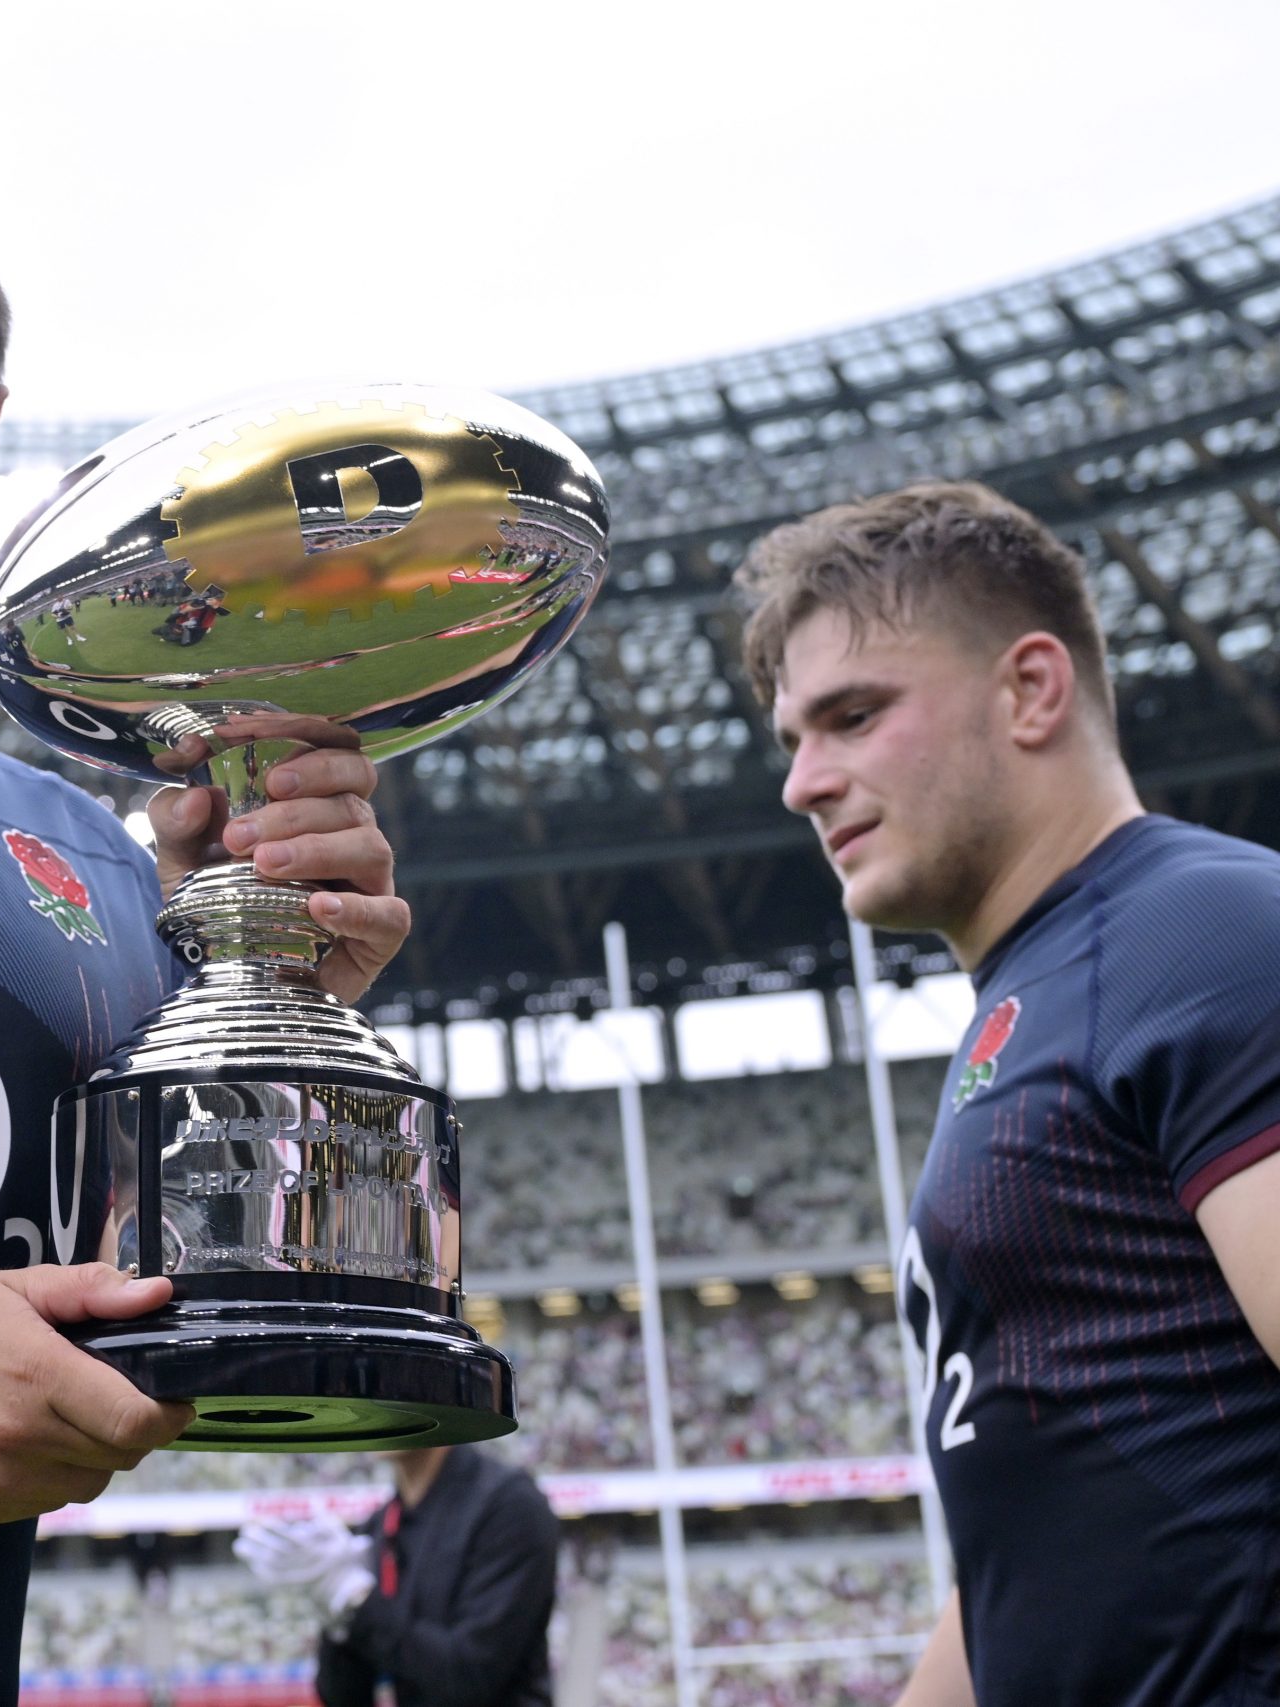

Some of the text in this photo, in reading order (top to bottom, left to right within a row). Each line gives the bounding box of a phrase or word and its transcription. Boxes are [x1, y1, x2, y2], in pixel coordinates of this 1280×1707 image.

[286, 443, 425, 556] D
[185, 1168, 275, 1195] PRIZE
[279, 1169, 318, 1194] OF
